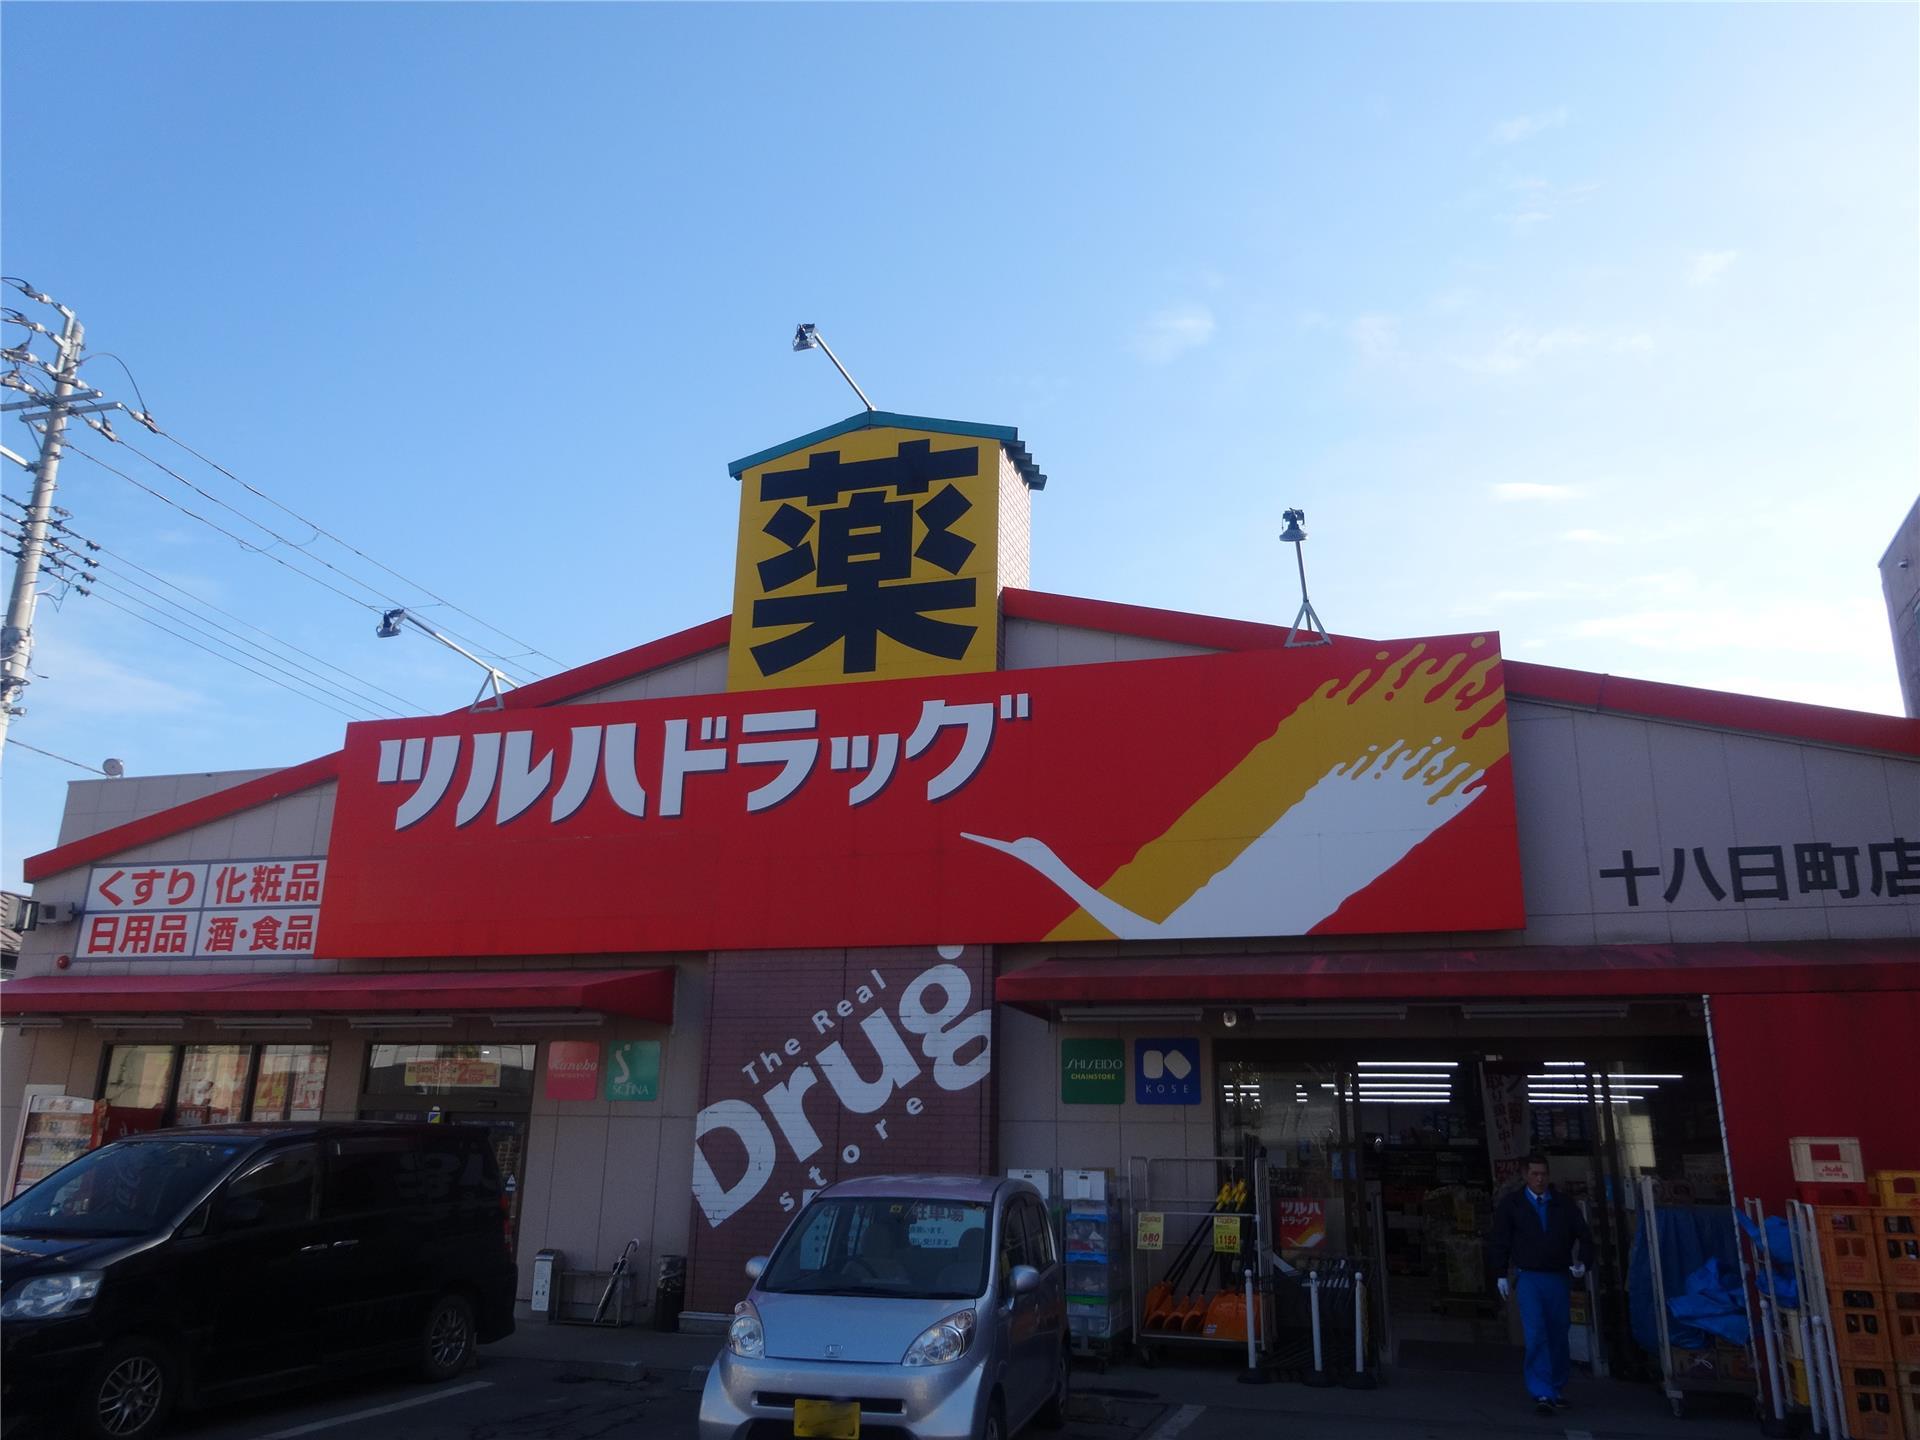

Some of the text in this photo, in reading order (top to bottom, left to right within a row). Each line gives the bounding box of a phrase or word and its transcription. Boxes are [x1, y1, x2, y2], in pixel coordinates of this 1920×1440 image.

[750, 438, 979, 677] 薬
[377, 693, 1030, 831] ツルハドラッグ
[98, 863, 320, 906] くすり 化粧品
[1599, 838, 1920, 907] 十八日町店
[88, 915, 313, 954] 日用品 酒・食品
[741, 969, 887, 1085] The Real
[692, 945, 992, 1228] Drug
[1065, 1058, 1123, 1070] SHISEIDO
[1070, 1072, 1116, 1080] CHAINSTORE
[779, 1097, 924, 1212] store
[1280, 1215, 1312, 1225] ドラッグ
[1281, 1201, 1321, 1215] ツルハ
